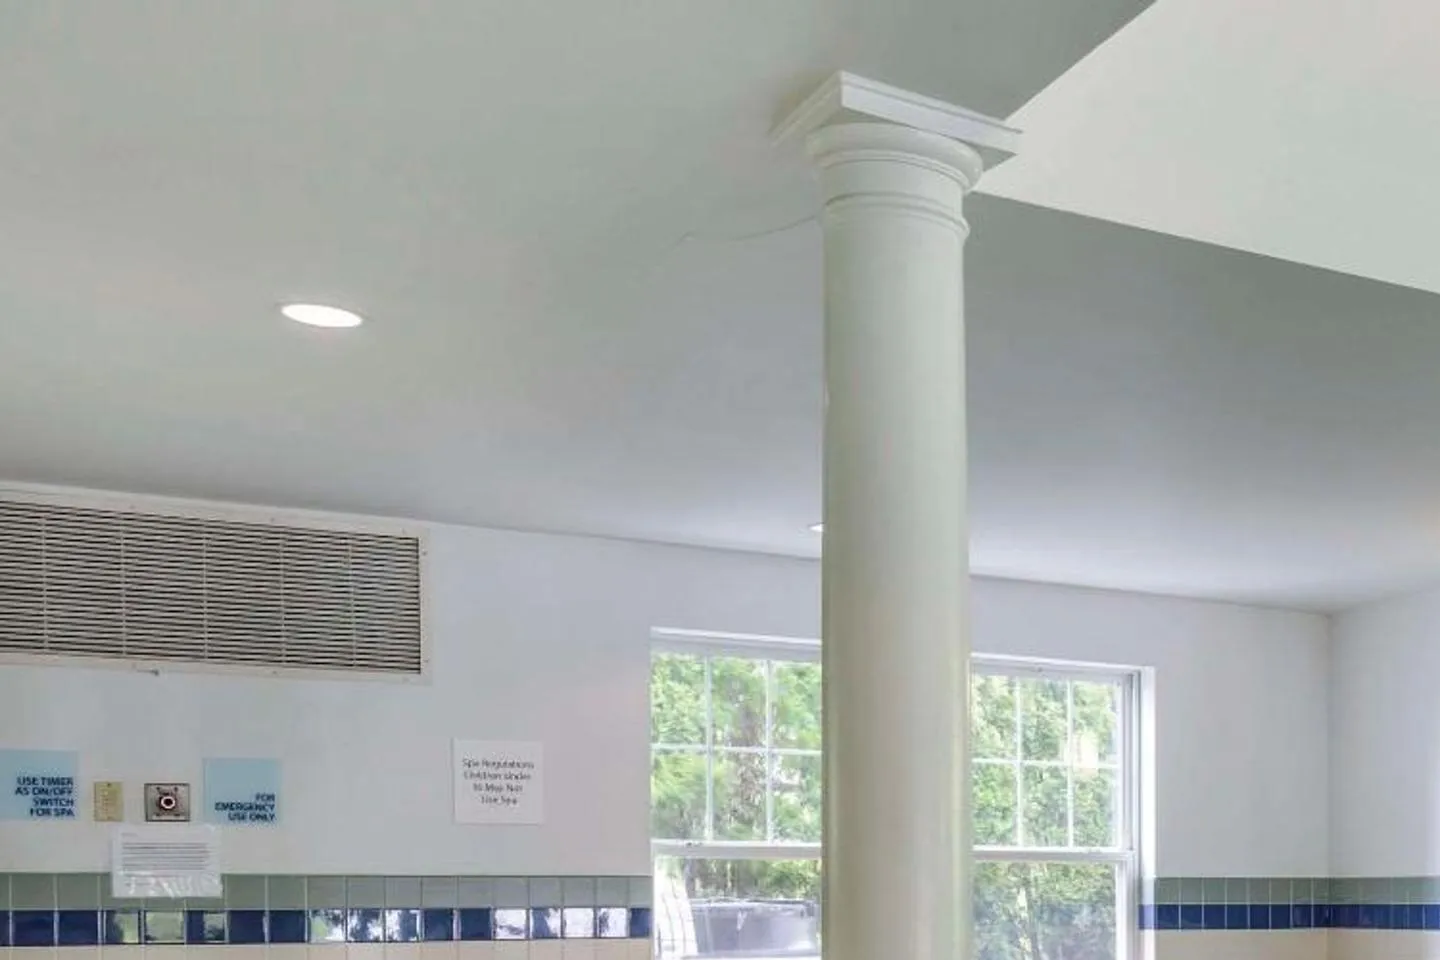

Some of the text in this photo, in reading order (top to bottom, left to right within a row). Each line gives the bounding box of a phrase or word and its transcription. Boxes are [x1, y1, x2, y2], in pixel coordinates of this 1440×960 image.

[482, 759, 534, 770] Regulations
[16, 776, 74, 786] USE TIMER
[15, 786, 73, 797] AS ON/OFF
[33, 797, 74, 807] SWITCH
[255, 793, 275, 802] FOR
[214, 801, 275, 812] EMERGENCY
[29, 807, 75, 818] FOR SPA
[228, 812, 276, 823] USE ONLY
